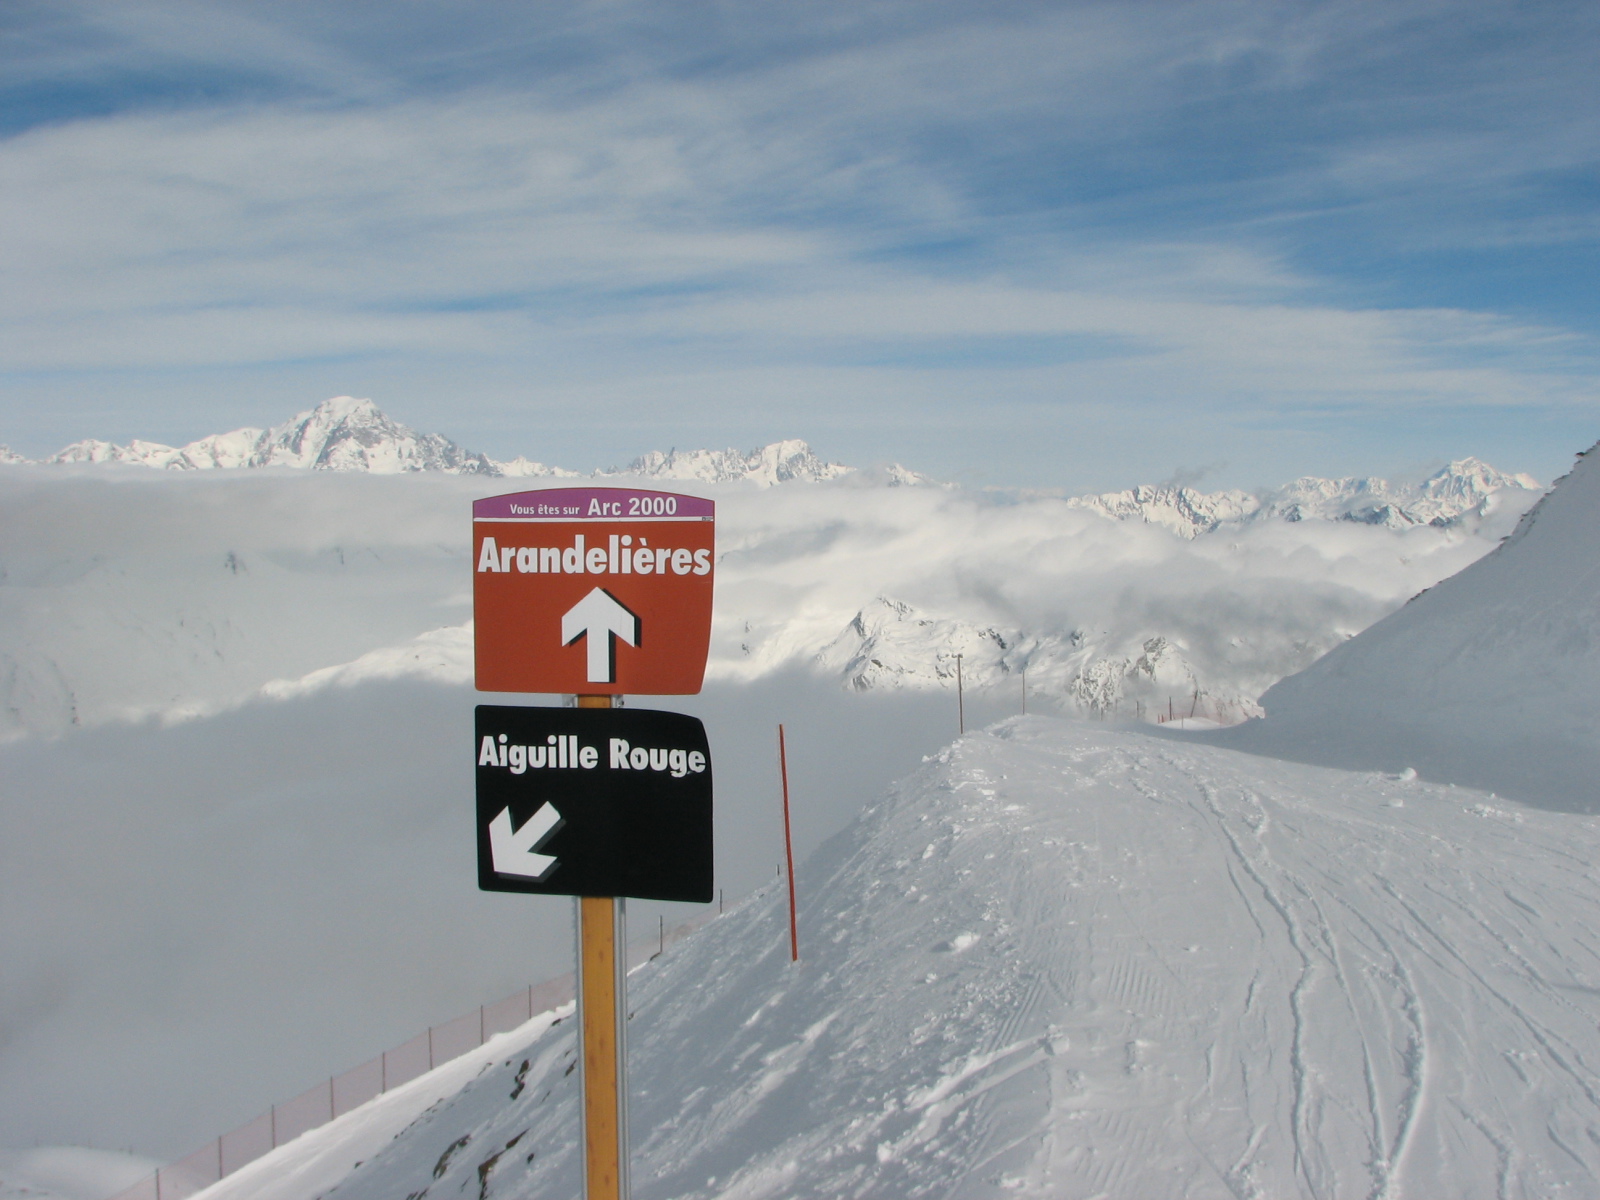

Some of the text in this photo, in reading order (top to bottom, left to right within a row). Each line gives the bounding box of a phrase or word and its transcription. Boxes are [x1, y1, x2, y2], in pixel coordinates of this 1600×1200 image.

[510, 497, 677, 515] Vous êtes sur Arc 2000
[477, 534, 711, 575] Arandelières
[478, 733, 706, 778] Aiguille Rouge
